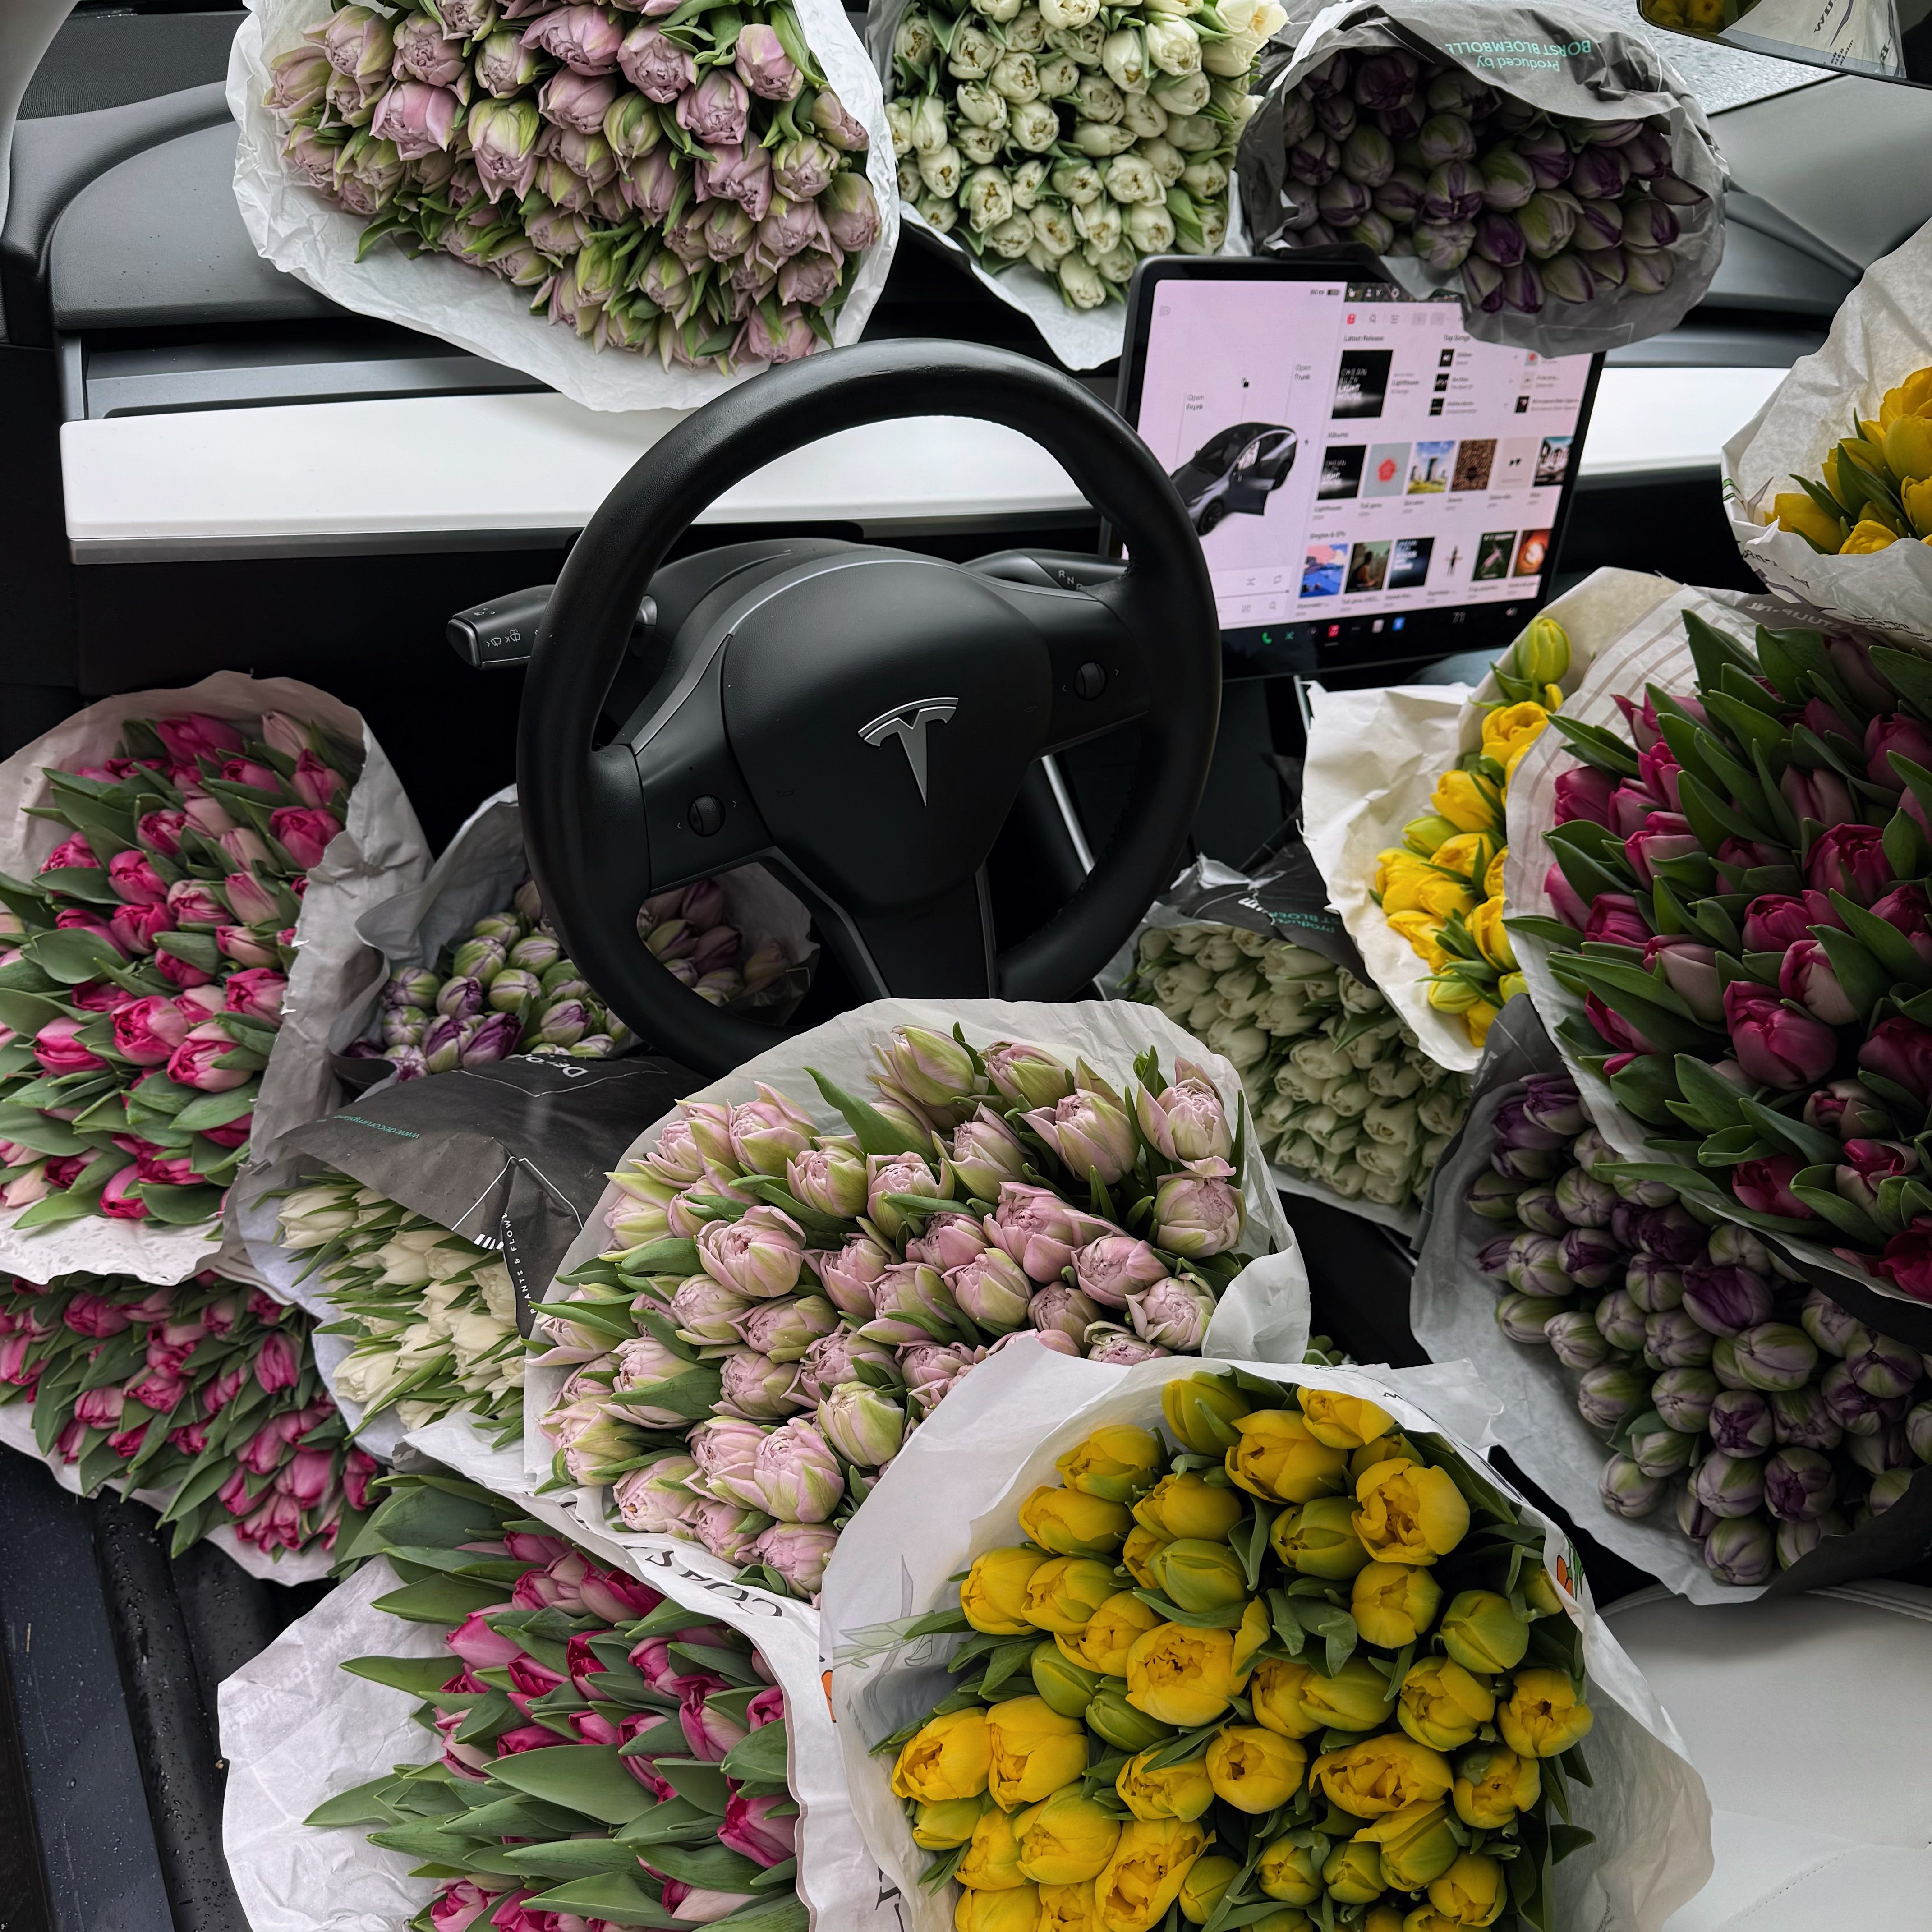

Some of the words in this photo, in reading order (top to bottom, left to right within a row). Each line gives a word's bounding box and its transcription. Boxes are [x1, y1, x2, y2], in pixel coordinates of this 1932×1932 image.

[1542, 40, 1592, 57] BORST
[1476, 55, 1495, 69] by
[1497, 57, 1560, 72] Produced
[1058, 570, 1065, 578] R
[516, 1269, 538, 1315] PANTS
